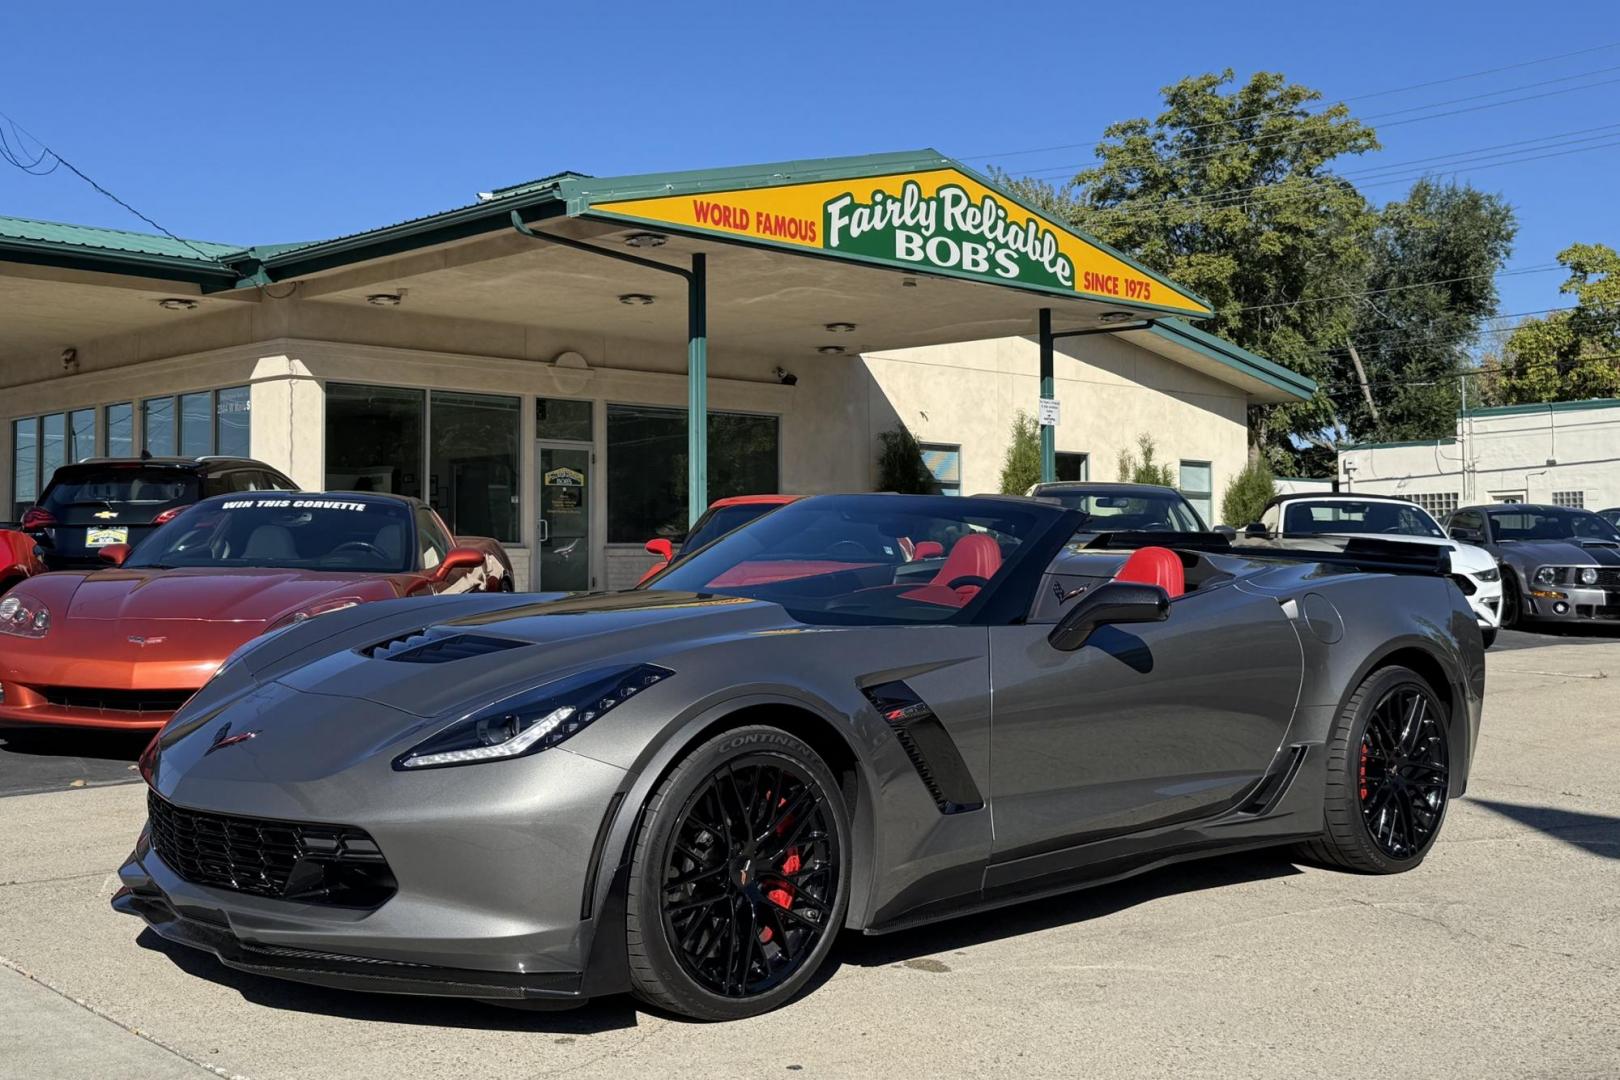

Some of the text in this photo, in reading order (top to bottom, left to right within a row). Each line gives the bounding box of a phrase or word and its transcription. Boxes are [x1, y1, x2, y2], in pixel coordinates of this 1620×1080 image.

[693, 199, 817, 242] WORLD FAMOUS
[827, 183, 1073, 287] Fairly Reliable
[895, 229, 1021, 279] BOB'S
[1083, 271, 1151, 300] SINCE 1975
[222, 500, 366, 512] WIN THIS CORVETTE
